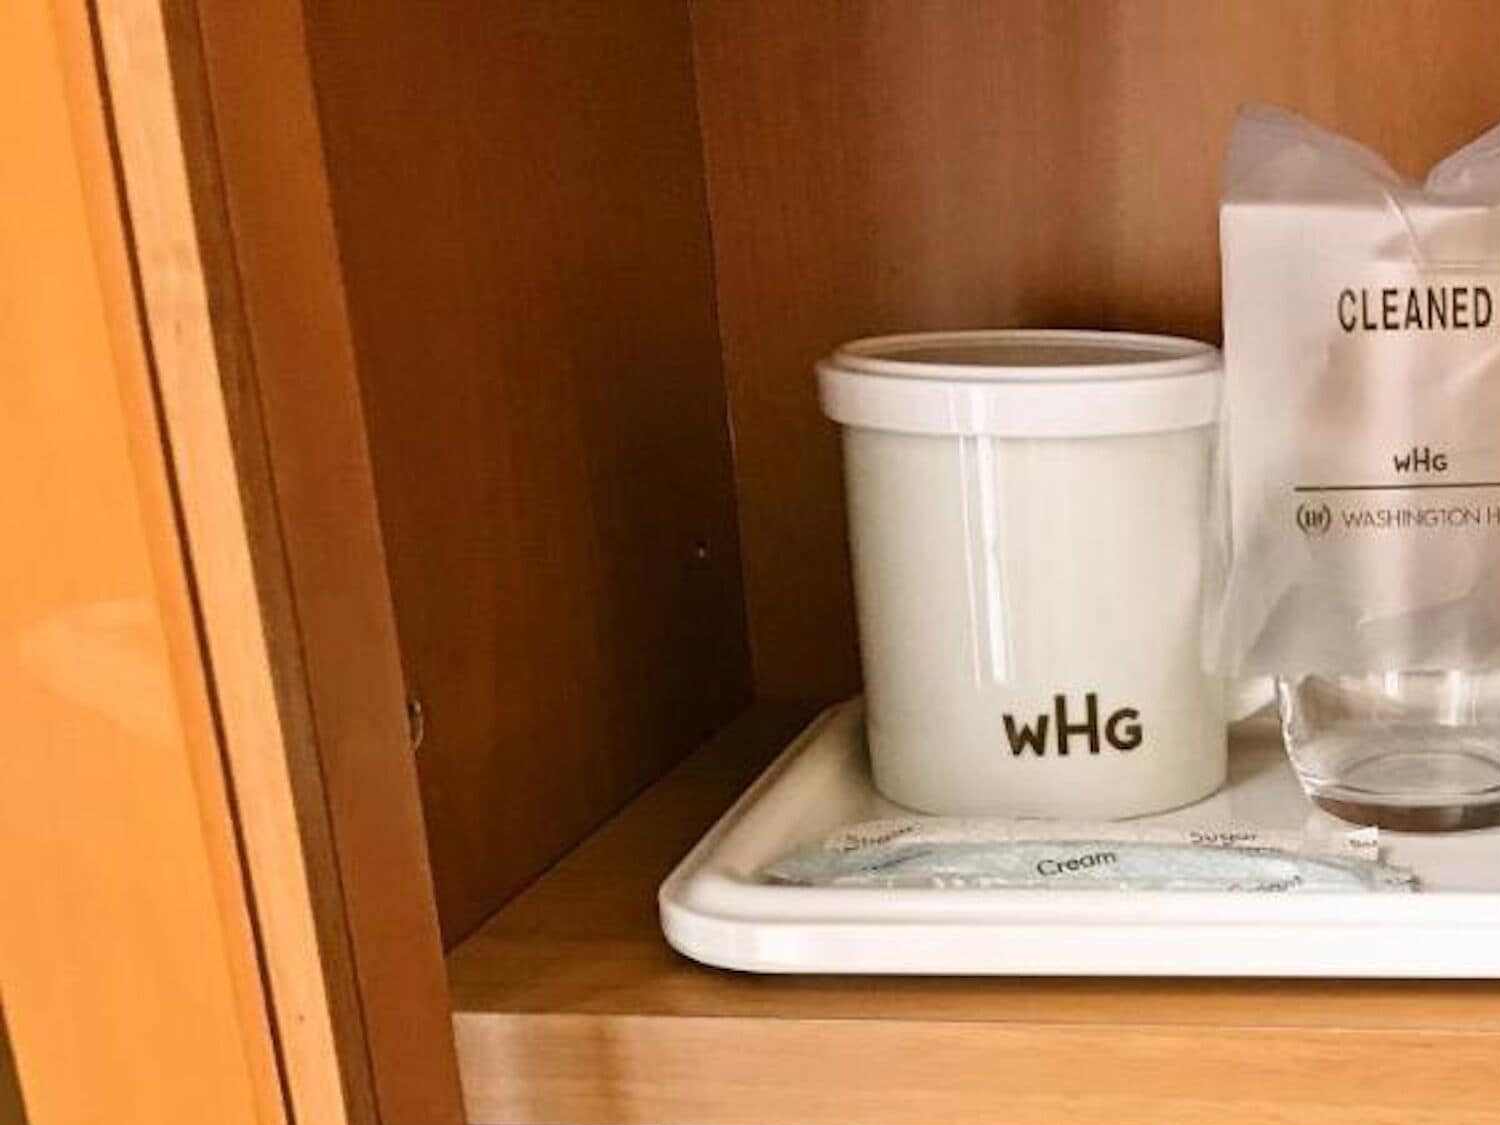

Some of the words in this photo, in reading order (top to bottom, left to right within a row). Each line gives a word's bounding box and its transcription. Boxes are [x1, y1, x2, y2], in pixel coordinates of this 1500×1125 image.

[1337, 286, 1493, 333] CLEANED
[1342, 506, 1481, 528] WASHINGTON
[1036, 851, 1117, 877] Cream
